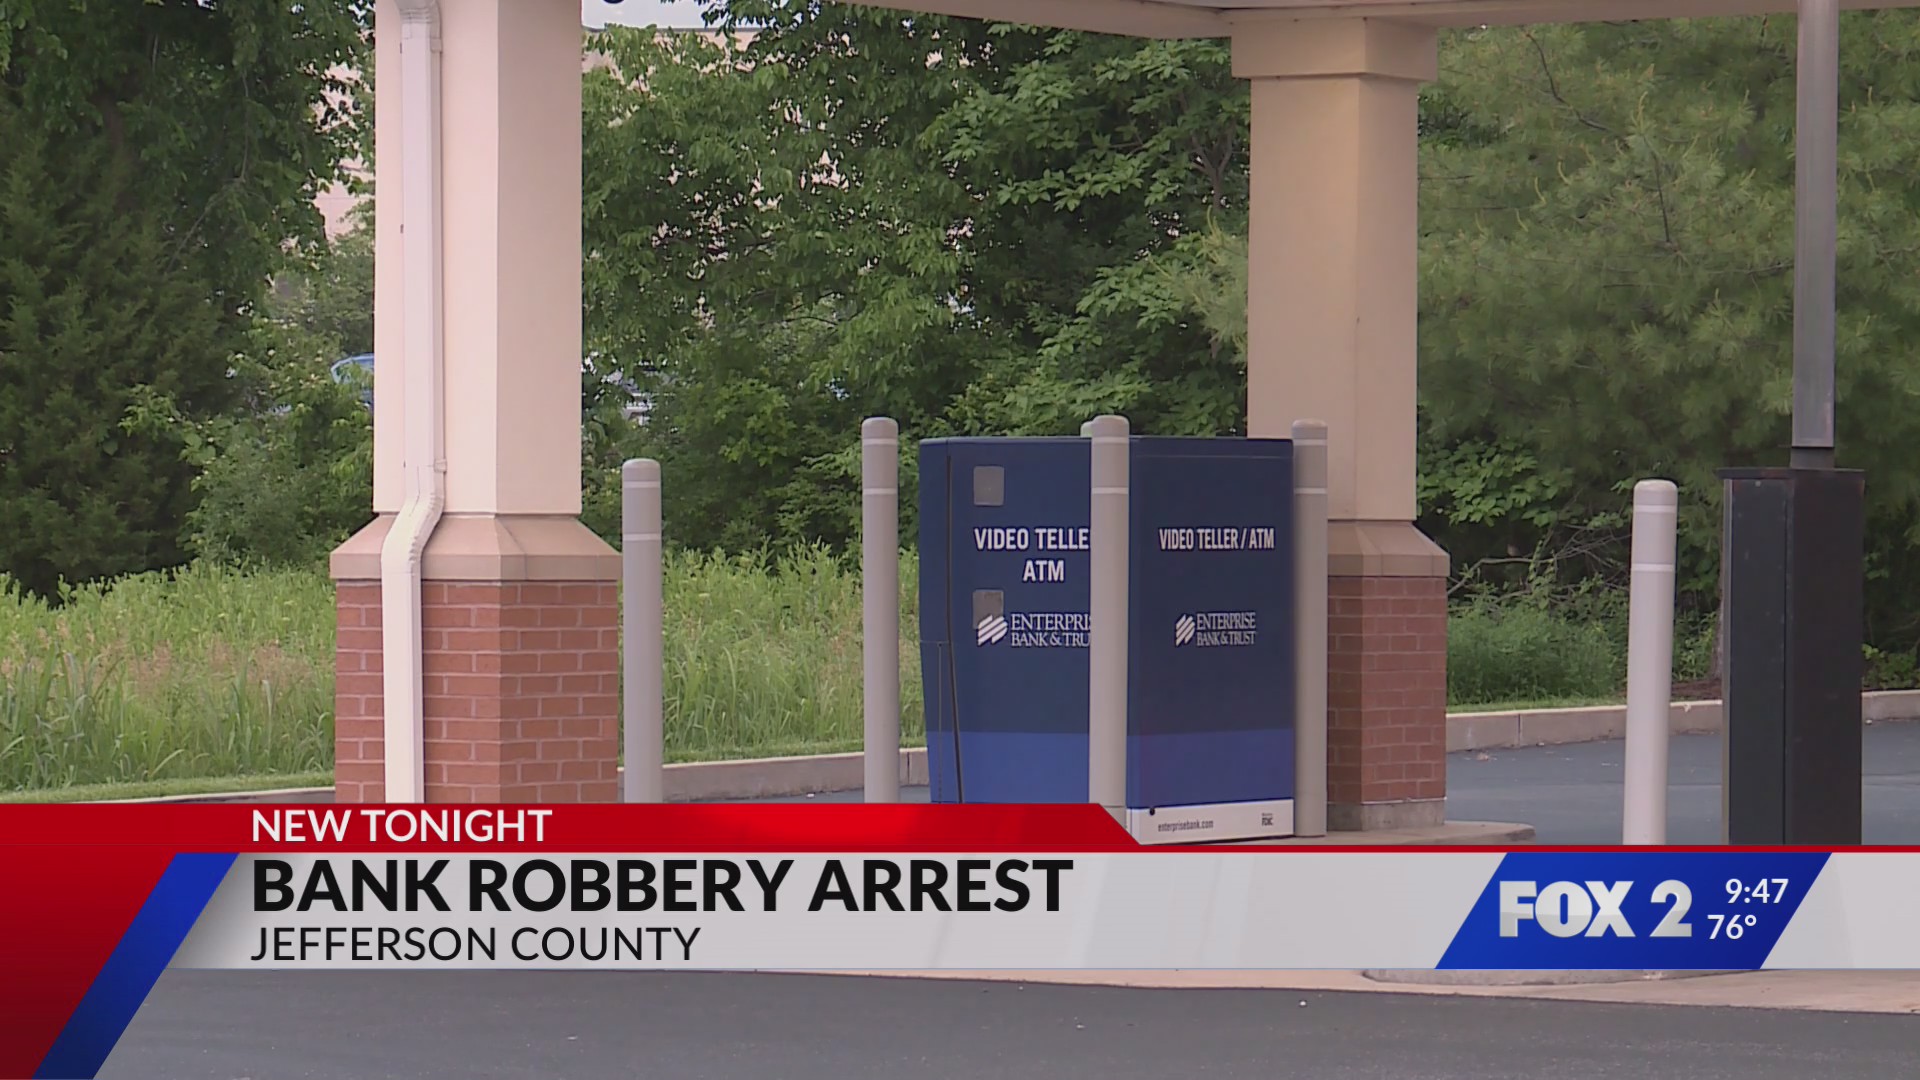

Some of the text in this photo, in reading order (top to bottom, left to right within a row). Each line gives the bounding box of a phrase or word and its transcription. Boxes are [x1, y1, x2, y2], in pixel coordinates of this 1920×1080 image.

[974, 527, 1090, 550] VIDEO TELLE
[1159, 528, 1195, 550] VIDEO
[1197, 528, 1239, 550] TELLER
[1248, 528, 1275, 549] ATM
[1023, 559, 1065, 582] ATM
[1011, 613, 1090, 631] ENTERPRI
[1196, 612, 1256, 630] ENTERPRISE
[1011, 632, 1090, 647] BANK & TRU
[1196, 631, 1256, 647] BANK & TRUST
[1157, 819, 1214, 833] enterprisebank.com
